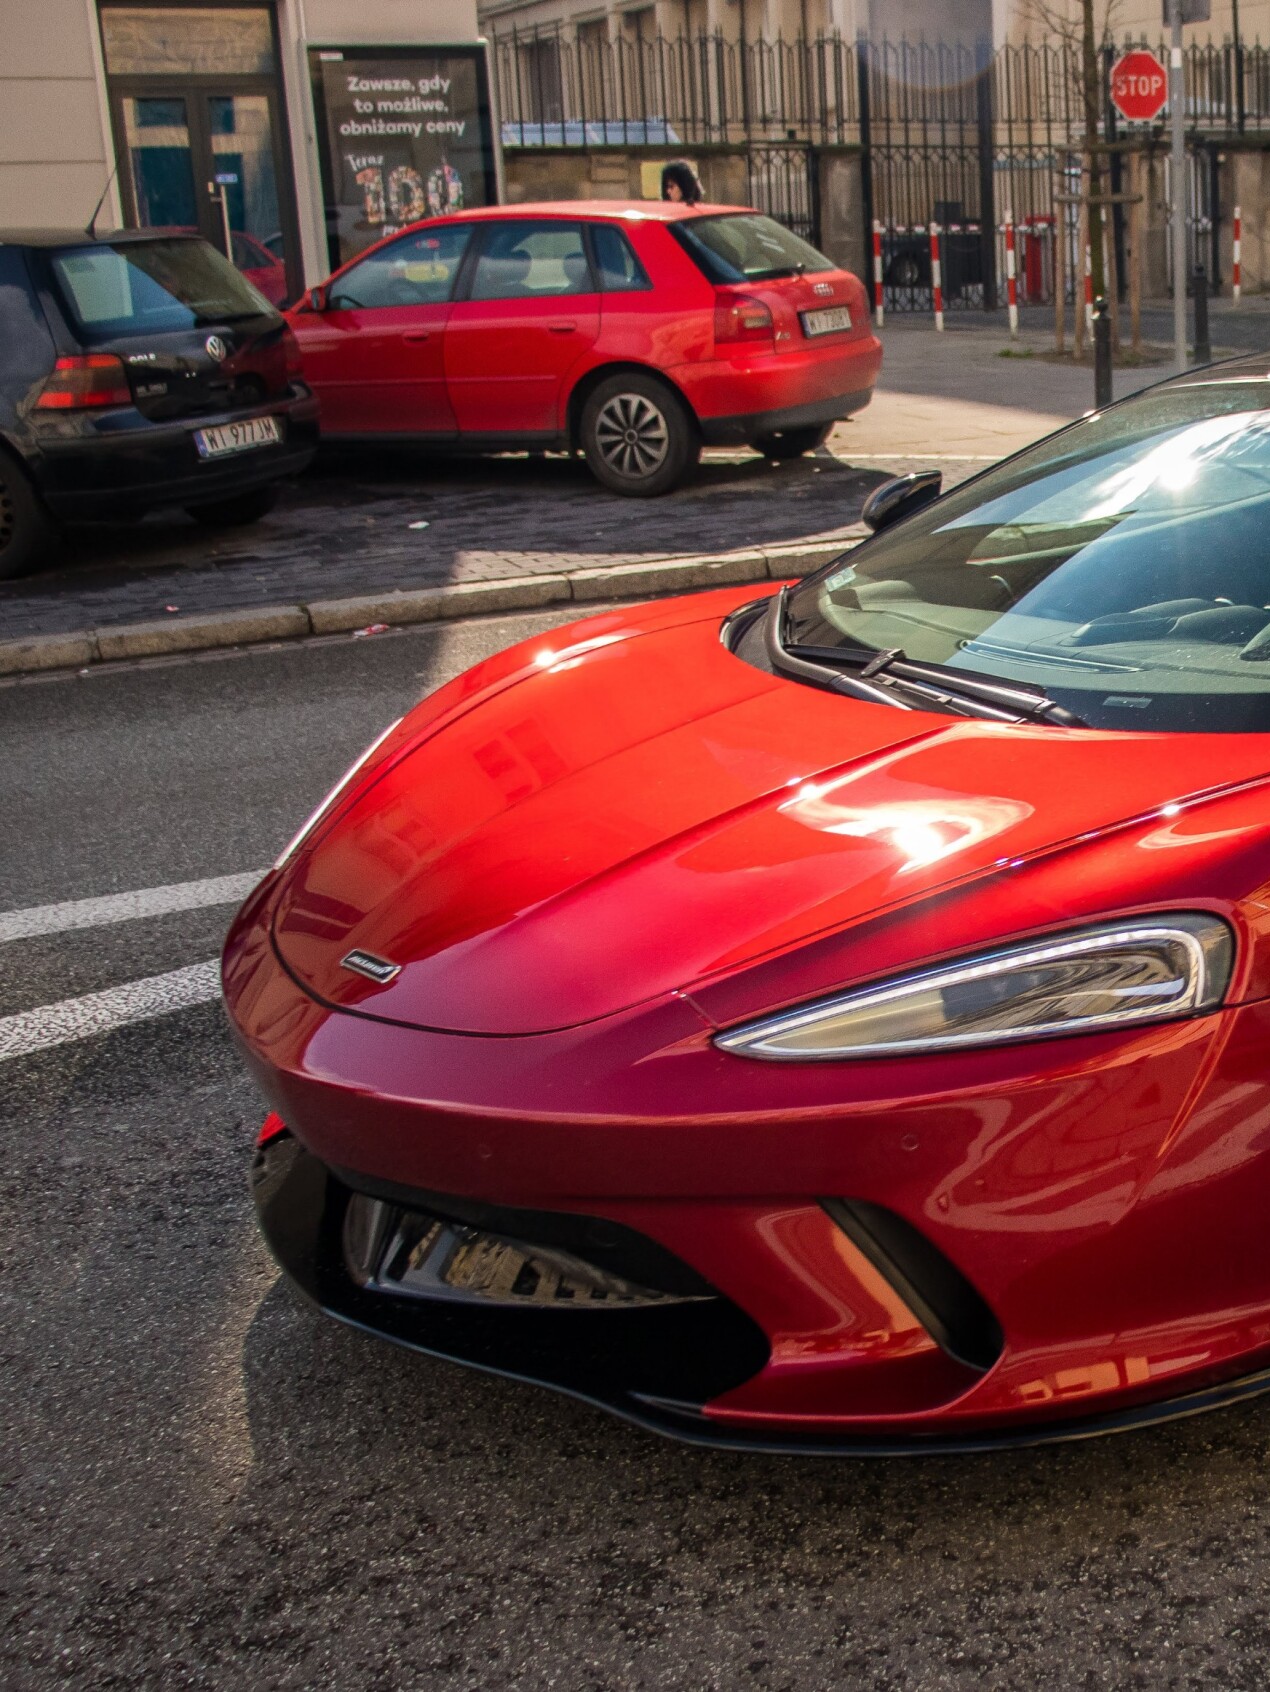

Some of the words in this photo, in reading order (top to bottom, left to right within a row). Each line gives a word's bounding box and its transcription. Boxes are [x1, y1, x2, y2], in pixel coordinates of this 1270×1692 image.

[348, 76, 415, 92] Zawsze,
[418, 75, 451, 94] gdy
[1116, 75, 1162, 96] STOP
[354, 99, 373, 113] to
[340, 119, 422, 137] obniżamy
[426, 120, 465, 136] ceny
[356, 165, 464, 223] 100
